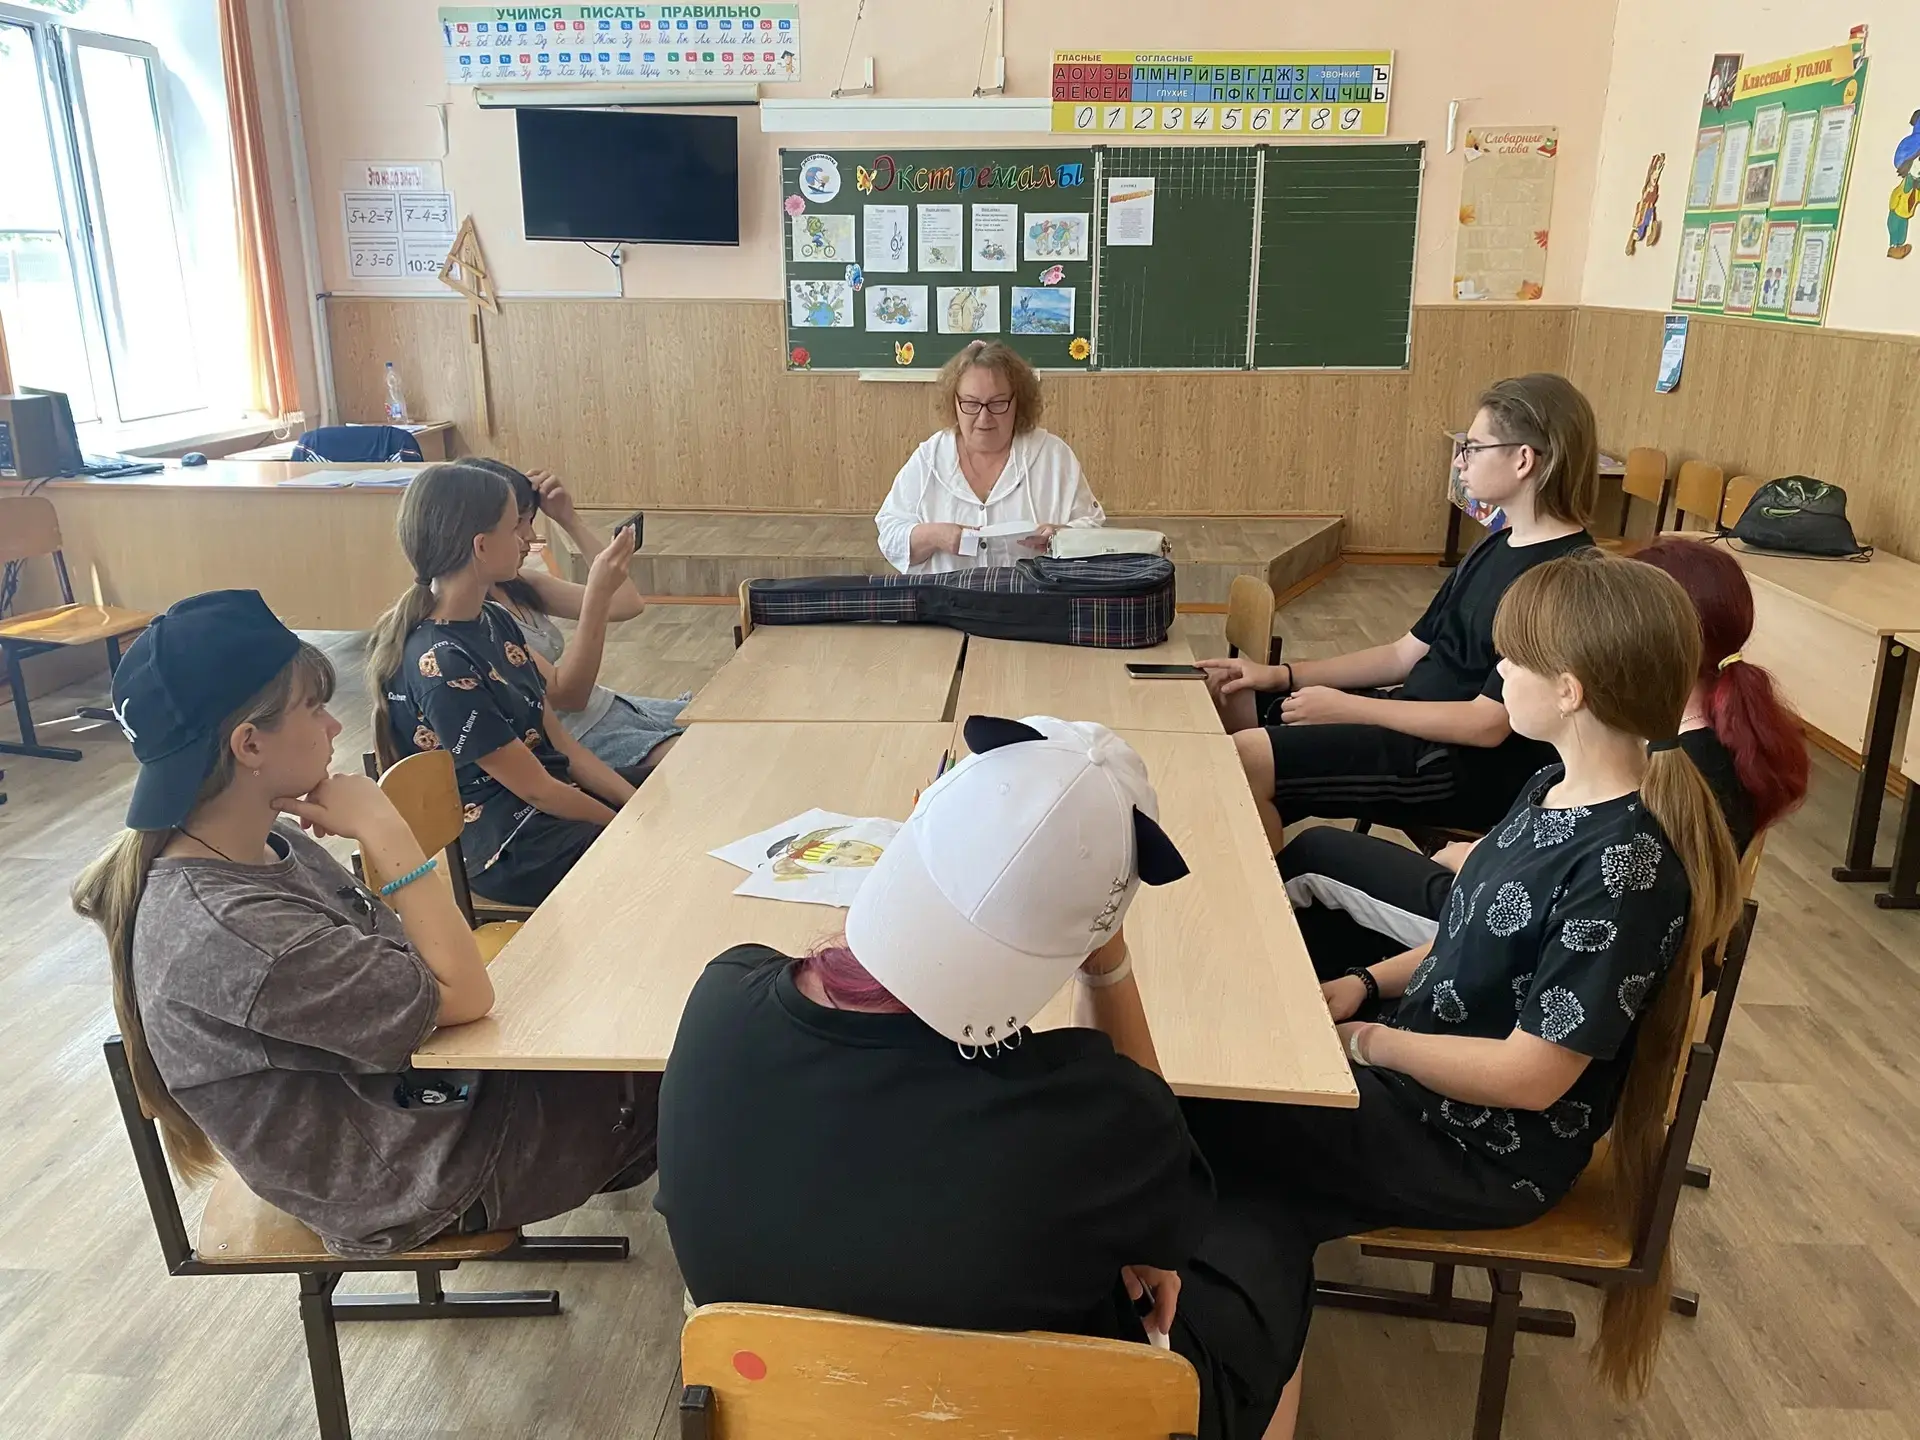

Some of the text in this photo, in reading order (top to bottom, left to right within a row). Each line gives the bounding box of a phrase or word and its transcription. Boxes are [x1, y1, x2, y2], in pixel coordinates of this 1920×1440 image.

[496, 6, 761, 21] УЧИМСЯ ПИСАТЬ ПРАВИЛЬНО
[1056, 54, 1193, 63] ГЛАСНЫЕ СОГЛАСНЫЕ
[1055, 64, 1387, 83] А О У Э Ы Л М Н Р Й Б В Г Д Ж З ЗВОНКИЕ Ъ
[1741, 58, 1834, 92] Классный уголок
[1055, 83, 1385, 102] Я Ё Ю Е И ГЛУХИЕ П Ф К Т Ш С Х Ц Ч Щ Ь
[1078, 106, 1361, 130] 0 1 2 3 4 5 6 7 8 9
[1484, 132, 1544, 154] Словарные слова
[872, 153, 1085, 196] Экстремалы
[451, 709, 479, 755] Street Culture
